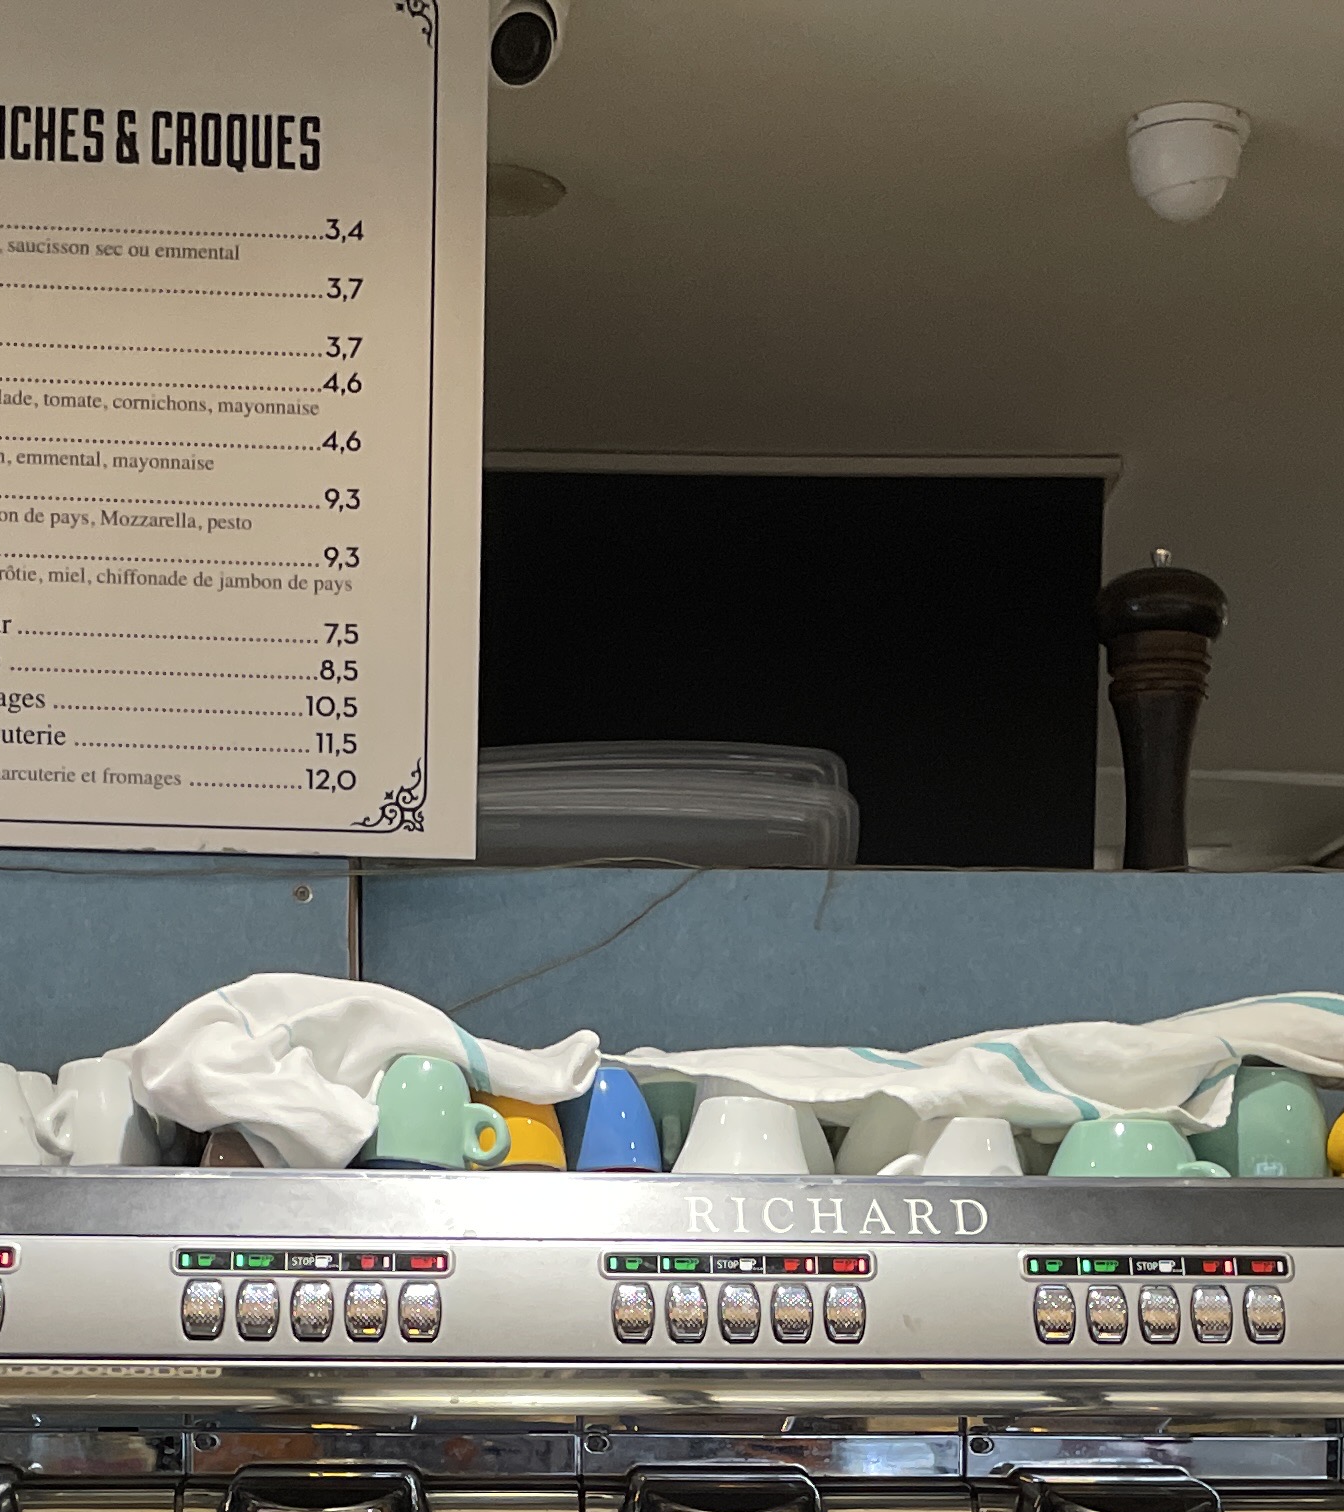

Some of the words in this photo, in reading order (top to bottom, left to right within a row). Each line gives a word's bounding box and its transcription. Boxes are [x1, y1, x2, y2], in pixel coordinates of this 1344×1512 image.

[115, 109, 140, 165] &
[151, 112, 322, 172] CROQUES
[325, 219, 364, 244] 3,4
[7, 236, 90, 255] saucisson
[154, 240, 240, 260] emmental
[327, 276, 364, 304] 3,7
[326, 336, 363, 362] 3,7
[321, 371, 362, 397] 4,6
[217, 396, 320, 420] mayonnaise
[320, 429, 361, 456] 4,6
[112, 451, 215, 476] mayonnaise
[325, 487, 360, 513] 9,3
[207, 514, 253, 536] pesto
[324, 546, 359, 572] 9,3
[96, 566, 188, 586] chiffonade
[217, 570, 283, 594] jambon
[313, 578, 353, 597] pays
[324, 623, 359, 648] 7,5
[320, 659, 358, 684] 8,5
[306, 695, 358, 721] 10,5
[316, 732, 357, 758] 11,5
[102, 767, 182, 792] fromages
[306, 768, 356, 794] 12,0
[684, 1195, 989, 1236] RICHARD
[291, 1256, 315, 1267] STOP
[716, 1259, 740, 1270] STOP
[1136, 1261, 1159, 1272] STOP
